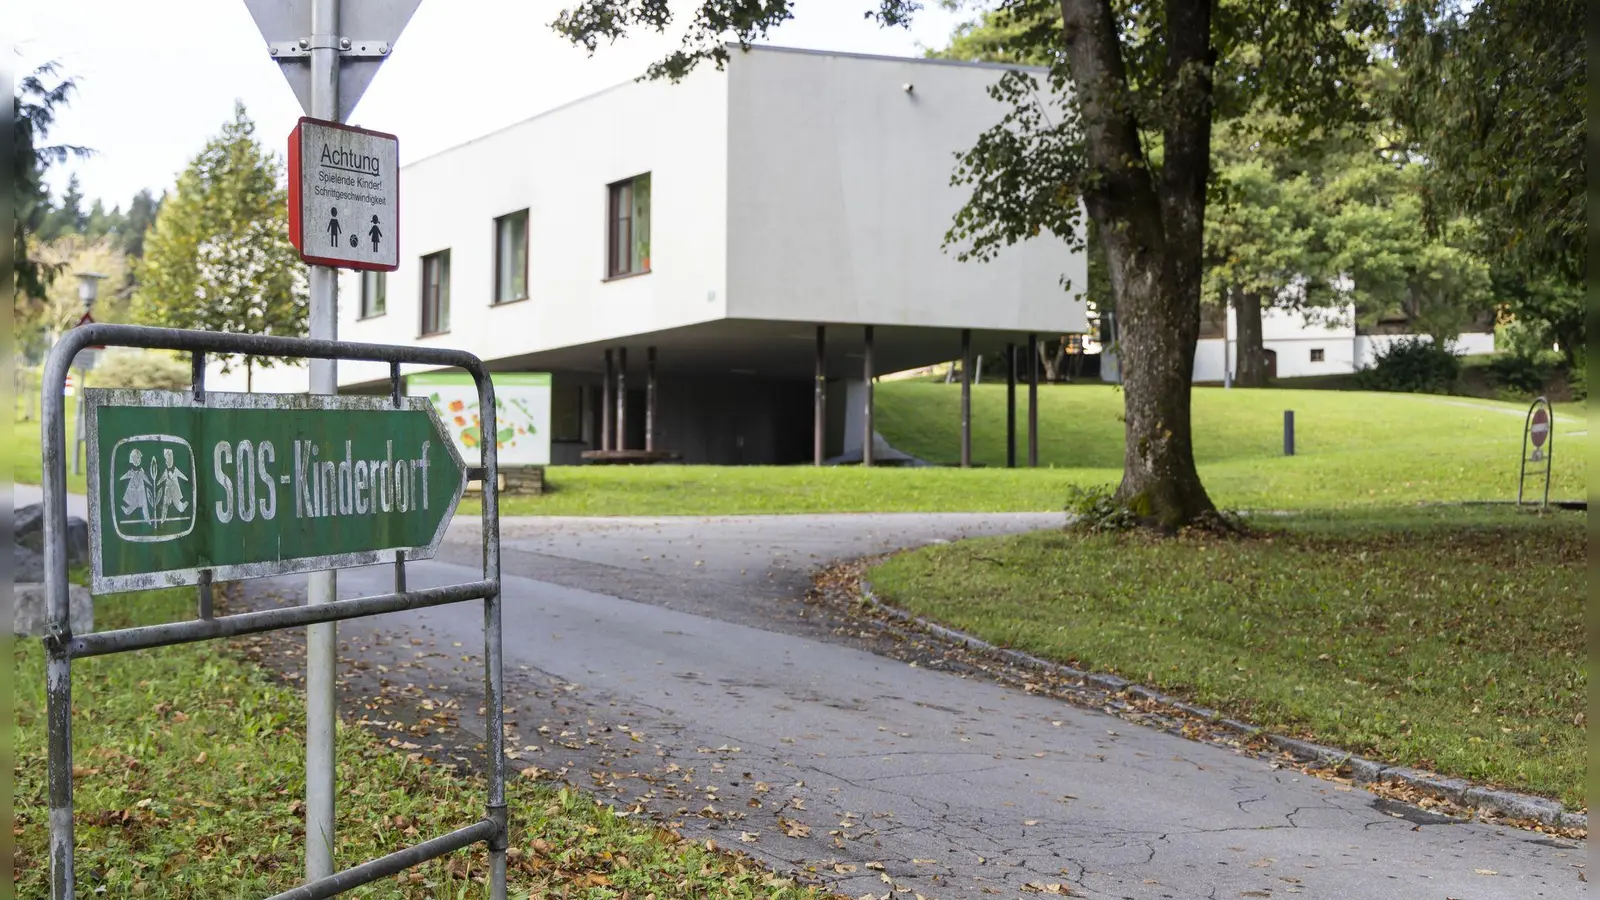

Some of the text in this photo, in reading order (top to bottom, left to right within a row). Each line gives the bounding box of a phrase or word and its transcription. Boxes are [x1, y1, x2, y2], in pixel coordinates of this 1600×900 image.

[320, 143, 380, 176] Achtung
[318, 171, 382, 191] Spielende Kinder!
[315, 186, 387, 206] Schrittgeschwindigkeit
[213, 439, 431, 524] SOS-Kinderdorf
